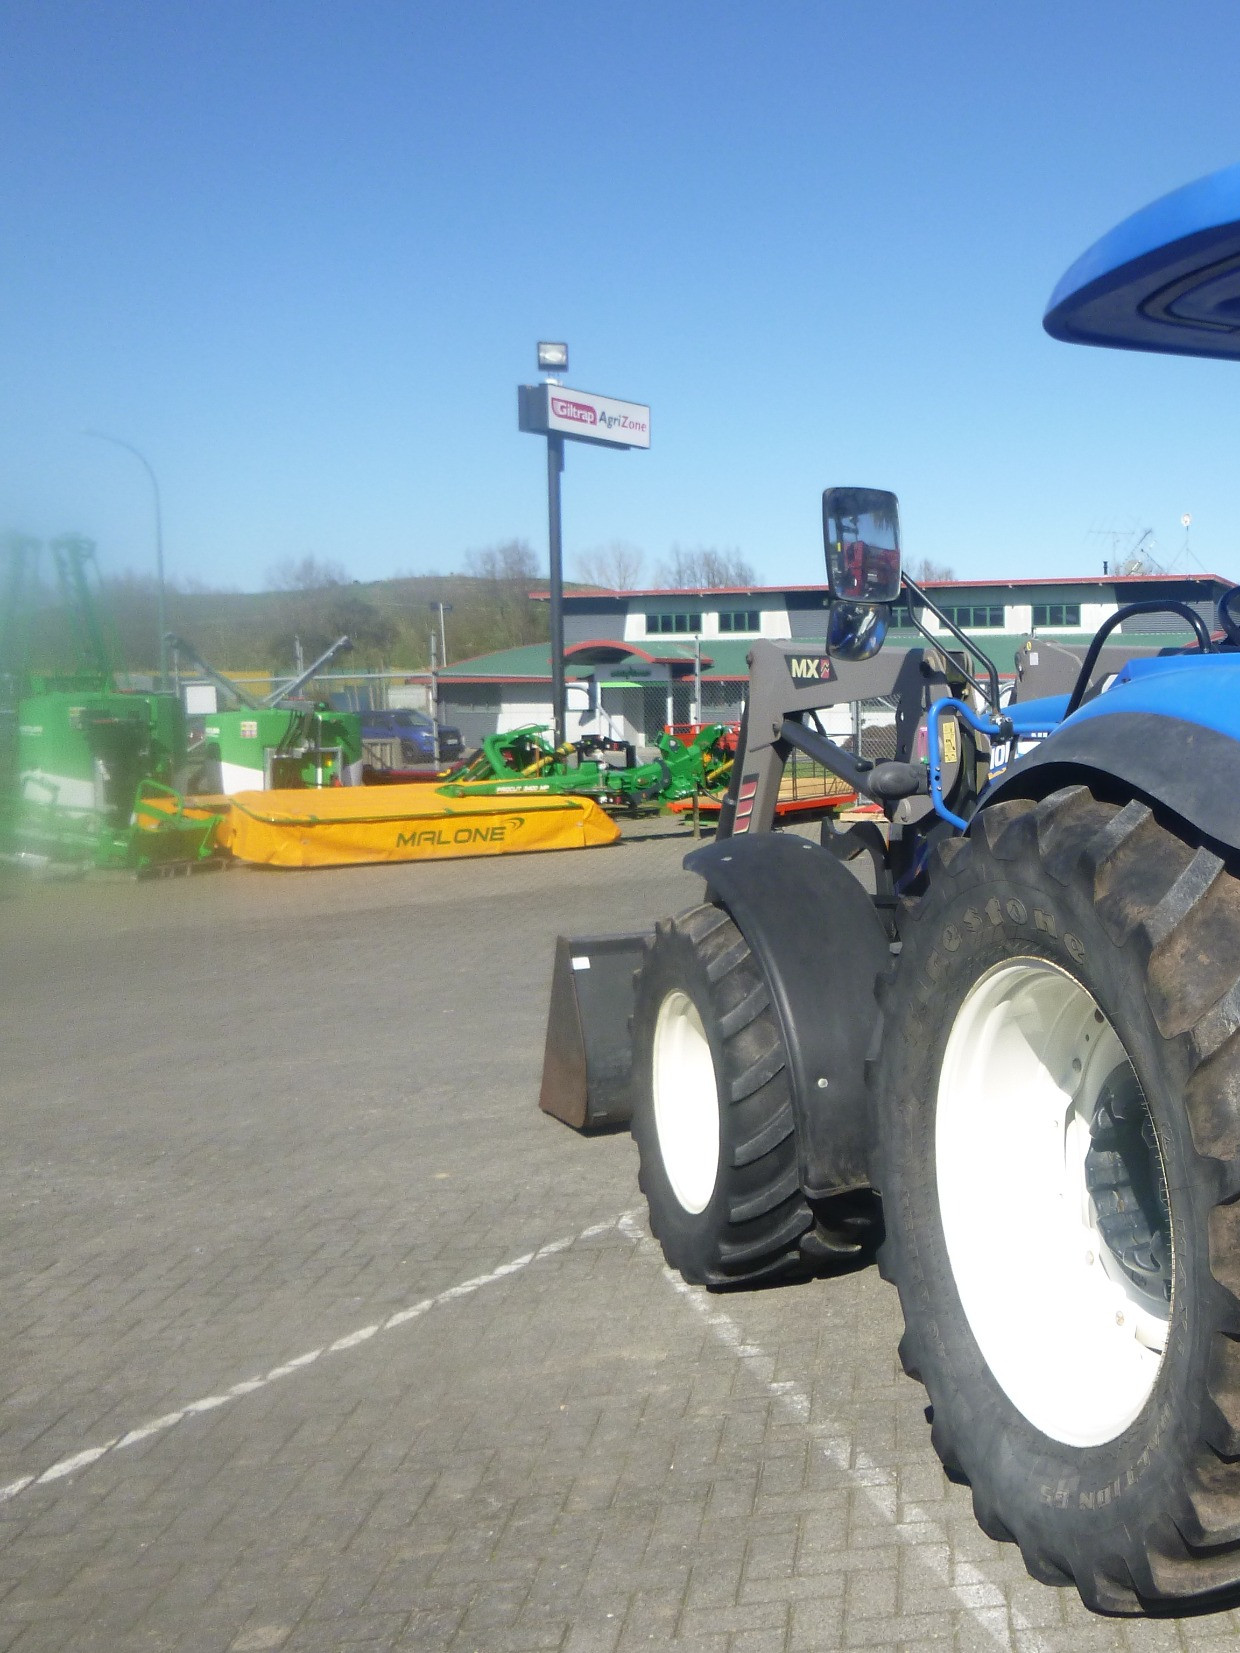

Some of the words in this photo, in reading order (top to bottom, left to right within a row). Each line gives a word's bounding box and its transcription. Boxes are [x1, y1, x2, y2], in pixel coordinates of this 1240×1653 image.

[558, 402, 594, 423] Giltrap
[599, 411, 647, 432] AgriZone
[791, 658, 820, 679] MX
[396, 826, 506, 847] MALONE
